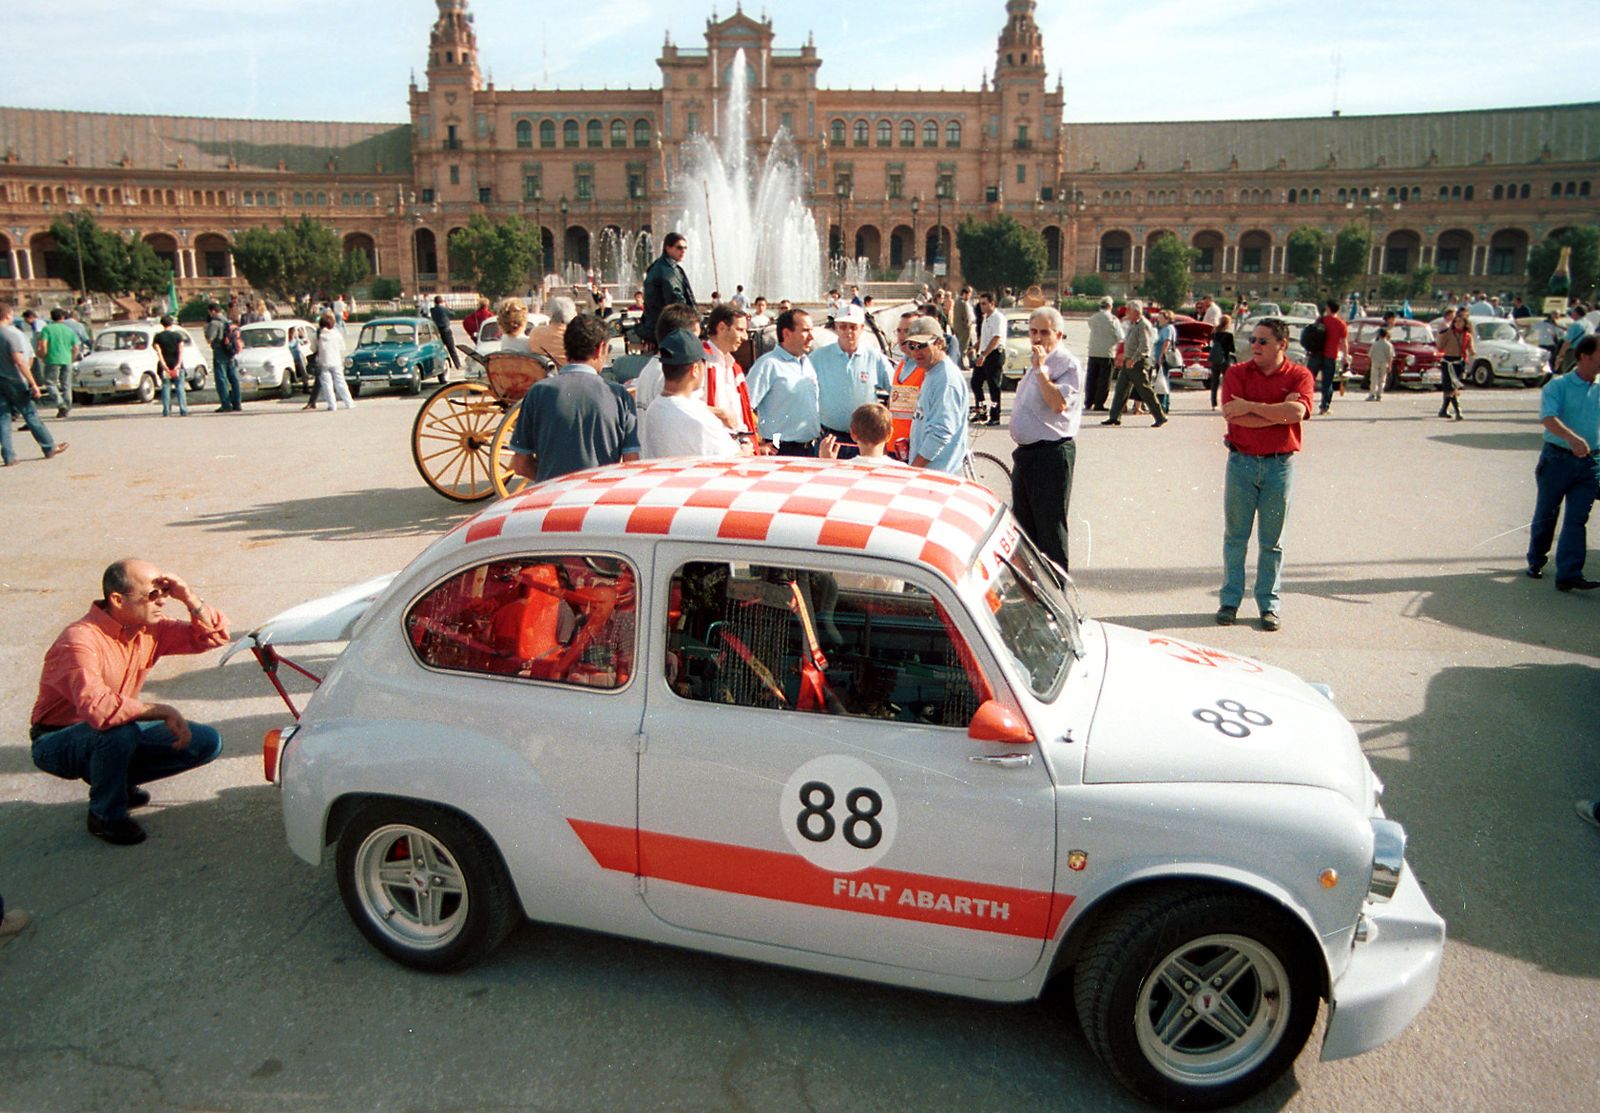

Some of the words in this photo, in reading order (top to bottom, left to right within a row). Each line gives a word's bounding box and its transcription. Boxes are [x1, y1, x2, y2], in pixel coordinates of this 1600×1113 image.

[1192, 698, 1273, 738] 88
[797, 781, 882, 849] 88
[833, 878, 891, 902] FIAT
[898, 888, 1010, 920] ABARTH
